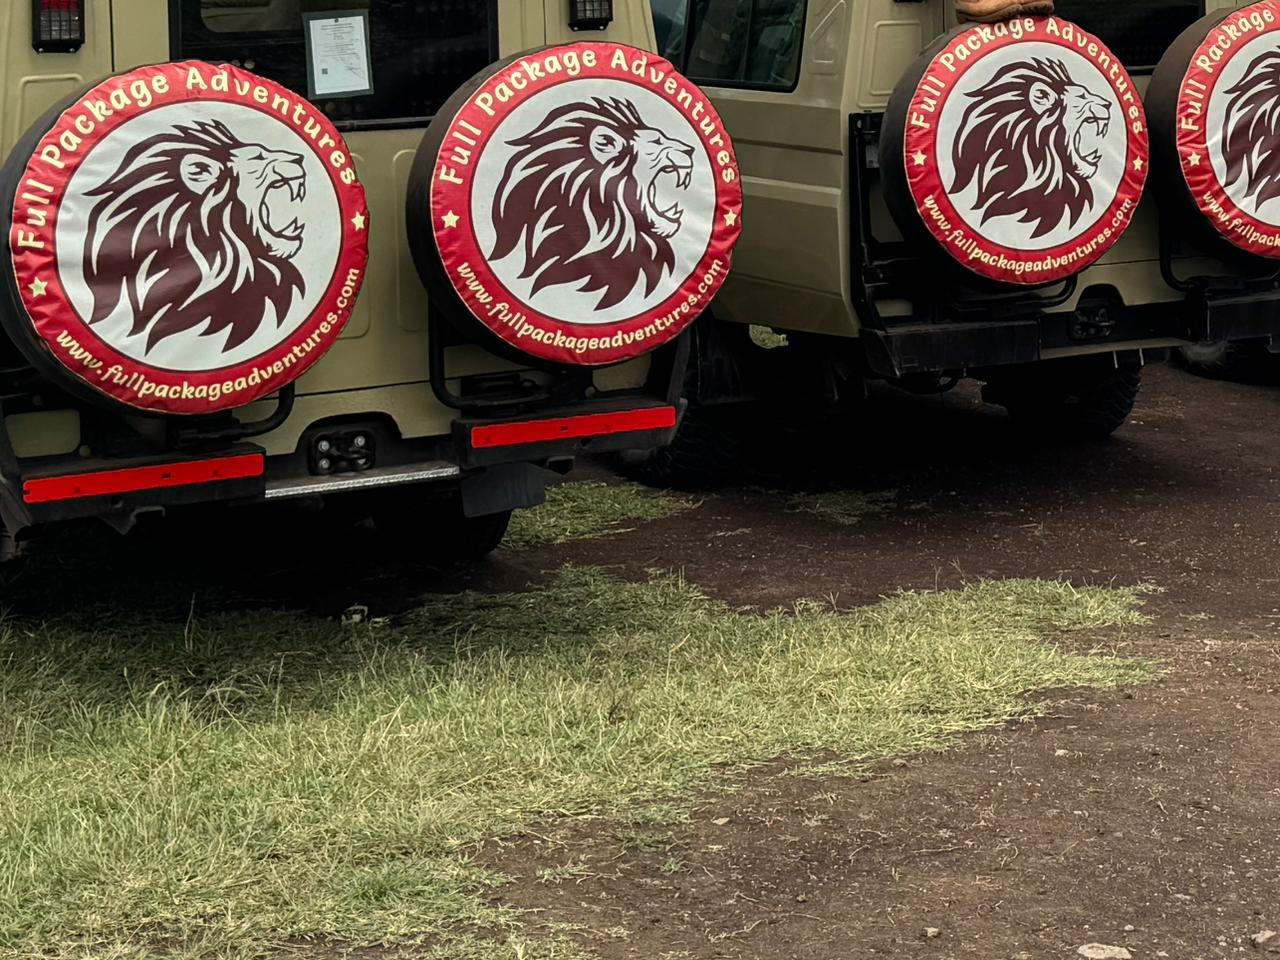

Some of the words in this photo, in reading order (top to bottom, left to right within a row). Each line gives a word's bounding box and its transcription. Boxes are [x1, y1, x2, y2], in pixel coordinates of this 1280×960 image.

[439, 119, 482, 185] Full
[475, 48, 597, 117] Package
[610, 48, 736, 183] Adventures
[911, 75, 946, 130] Full
[939, 17, 1036, 73] Package
[1045, 16, 1143, 134] Adventures
[1181, 79, 1207, 132] Full
[1196, 8, 1275, 74] Package
[17, 178, 54, 250] Full
[40, 75, 170, 169] Package
[186, 66, 356, 185] Adventures
[923, 194, 1132, 275] www.fullpackageadventures.com
[56, 267, 360, 401] www.fullpackageadventures.com
[456, 258, 723, 353] www.fullpackageadventures.com
